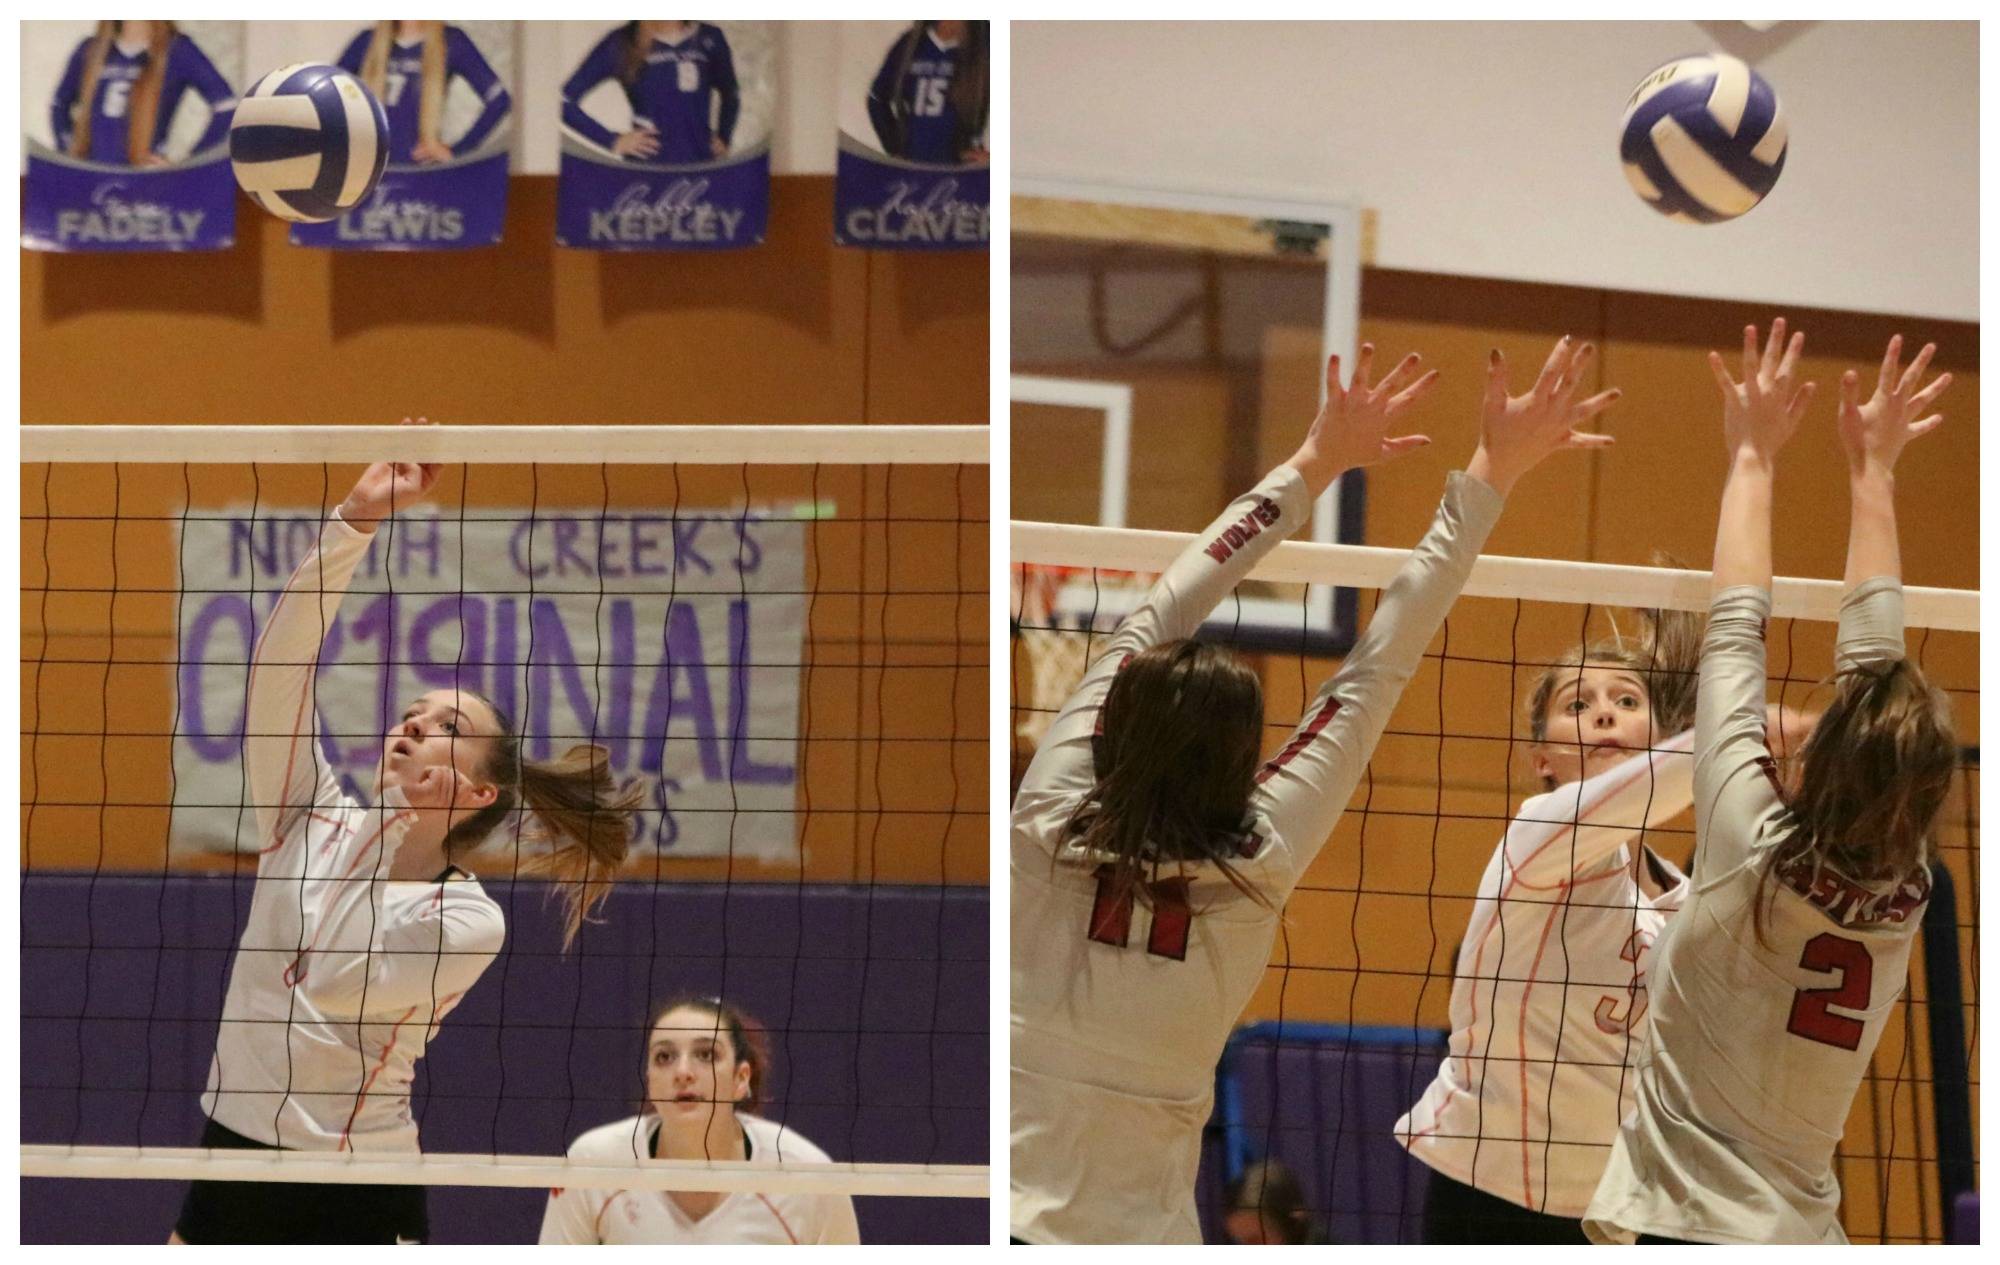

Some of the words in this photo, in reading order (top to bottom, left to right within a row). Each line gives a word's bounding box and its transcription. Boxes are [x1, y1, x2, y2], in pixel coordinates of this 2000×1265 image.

[914, 76, 949, 117] 15
[58, 209, 204, 243] FADELY
[338, 206, 465, 241] LEWIS
[588, 206, 744, 241] KEPLEY
[228, 514, 441, 579] NOTH
[508, 513, 763, 580] CREEK'S
[1203, 497, 1280, 564] WOLVES
[1786, 931, 1874, 1052] 2
